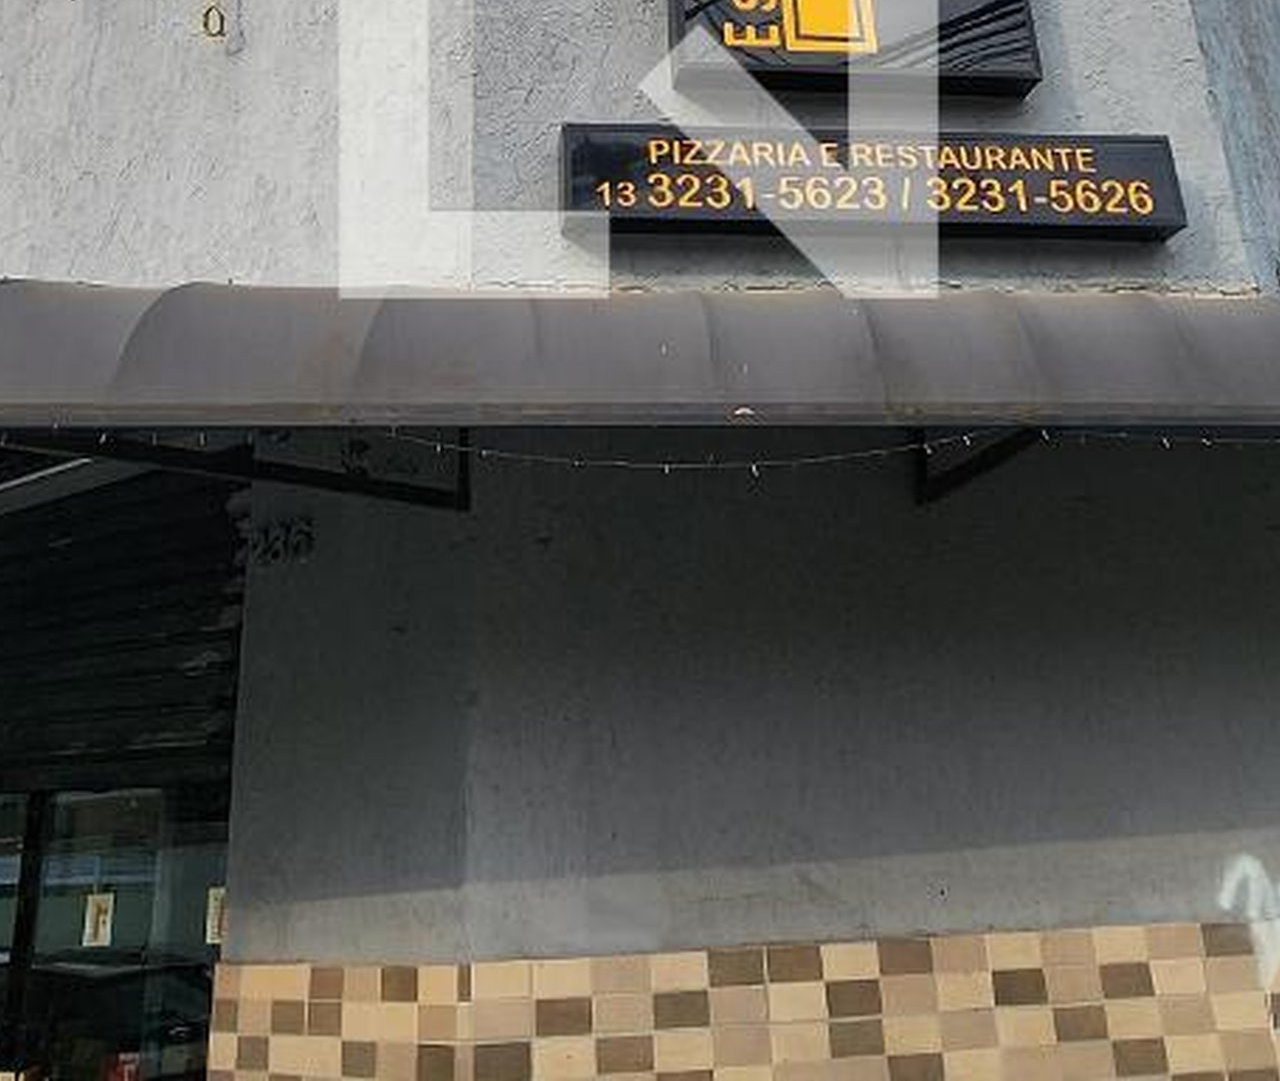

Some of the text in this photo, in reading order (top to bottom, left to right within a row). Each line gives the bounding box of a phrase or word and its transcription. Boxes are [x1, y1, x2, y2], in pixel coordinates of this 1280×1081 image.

[648, 139, 1097, 173] PIZZARIA E RESTAURANTE
[596, 180, 637, 208] 13
[647, 172, 887, 211] 3231-5623
[926, 177, 1154, 215] 3231-5626
